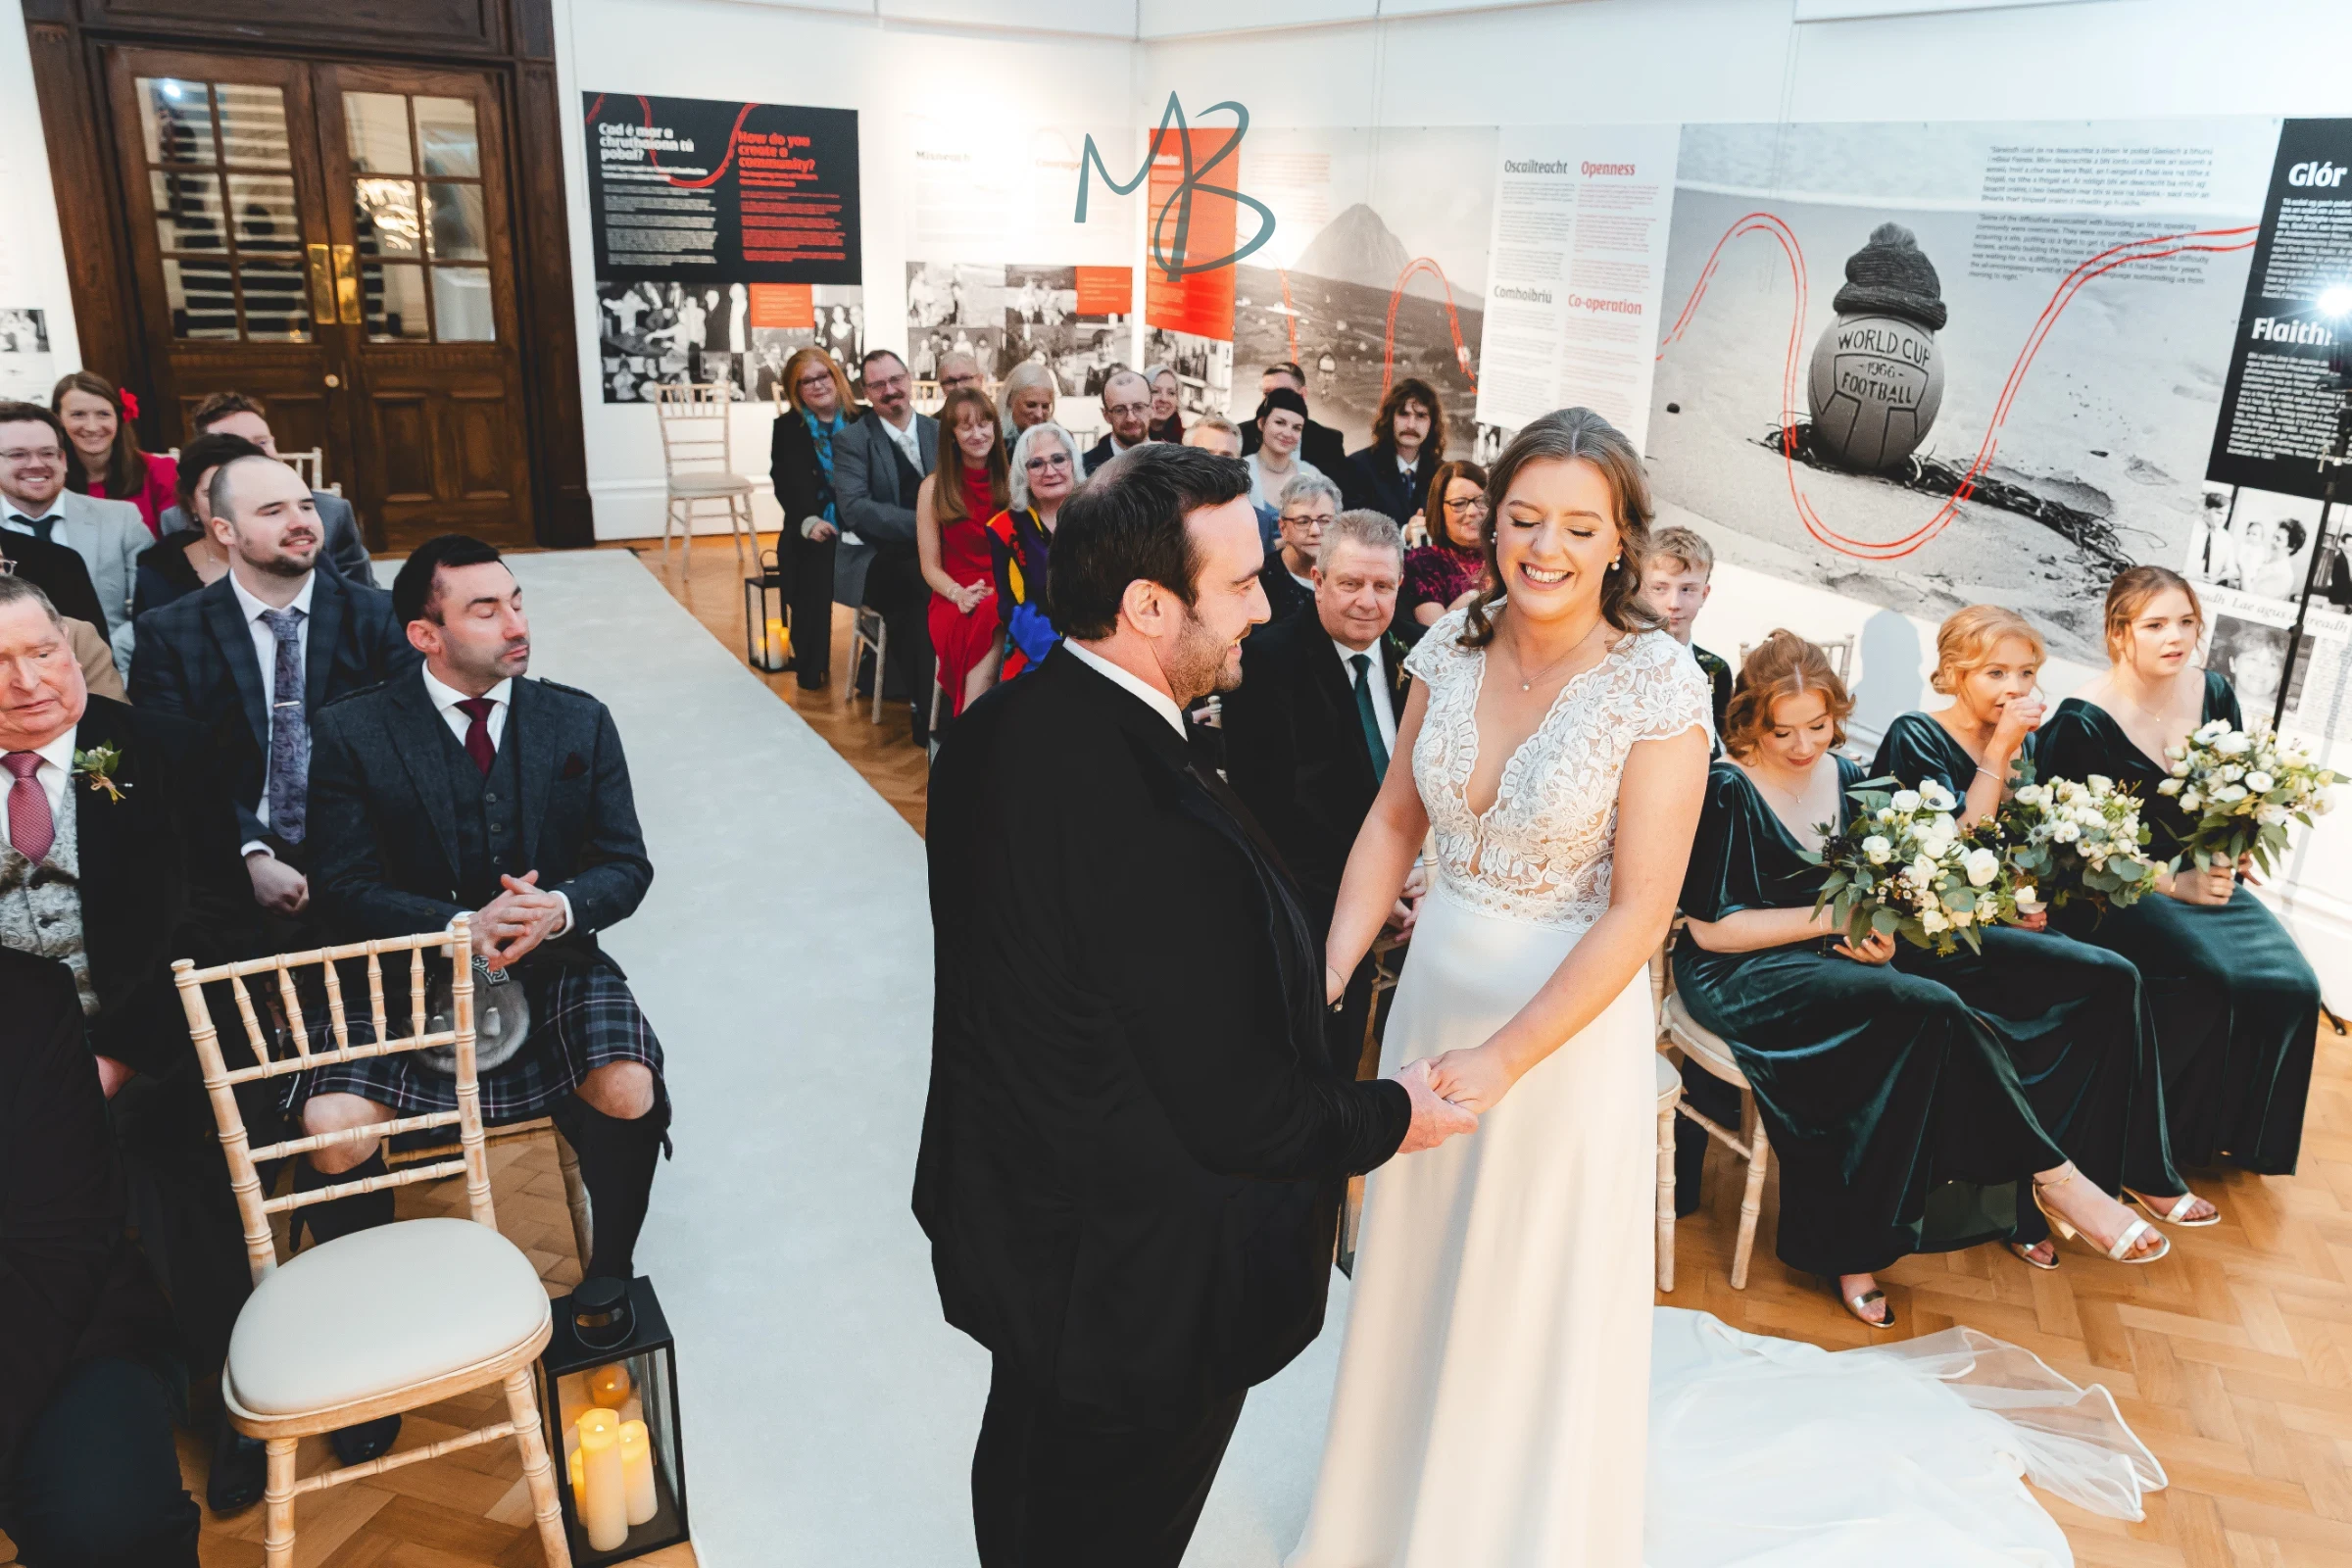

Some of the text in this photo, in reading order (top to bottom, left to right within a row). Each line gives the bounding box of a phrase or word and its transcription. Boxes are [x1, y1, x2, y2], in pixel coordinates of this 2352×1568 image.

[599, 122, 624, 136] Cad
[635, 126, 662, 138] mar
[738, 131, 810, 148] How do you
[738, 144, 789, 158] create a
[738, 157, 815, 173] community?
[1504, 160, 1568, 173] Oscailteacht
[1581, 161, 1636, 177] Openness
[2288, 161, 2348, 187] Glór
[1494, 285, 1552, 303] Comhoibriú
[1568, 293, 1642, 315] Co-operation
[1838, 328, 1931, 367] WORLD CUP
[1841, 371, 1912, 405] FOOTBALL
